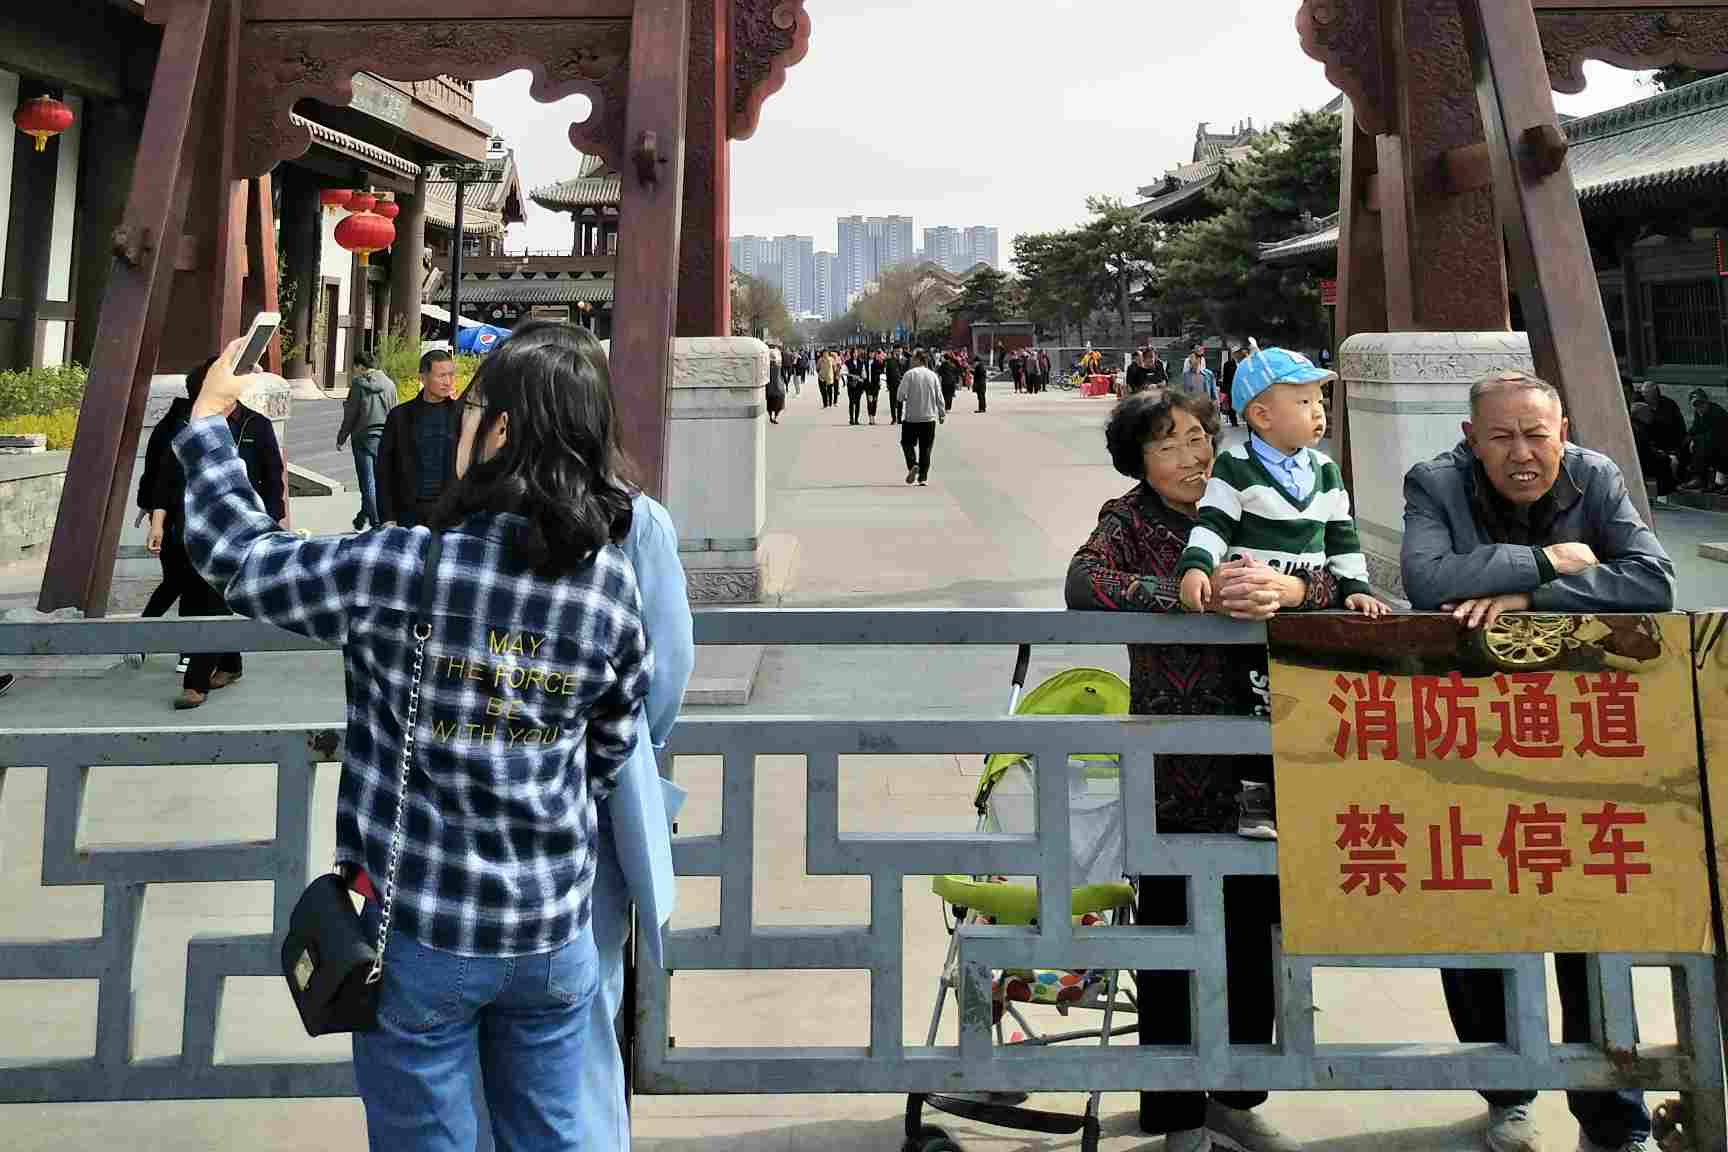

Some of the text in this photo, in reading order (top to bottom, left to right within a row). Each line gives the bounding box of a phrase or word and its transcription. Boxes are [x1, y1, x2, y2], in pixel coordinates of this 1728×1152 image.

[489, 629, 546, 658] MAY
[431, 654, 579, 696] THE FORCE
[486, 696, 525, 721] BE
[1328, 670, 1646, 761] 消防通道
[431, 720, 560, 750] WITH YOU
[1334, 801, 1652, 898] 禁止停车
